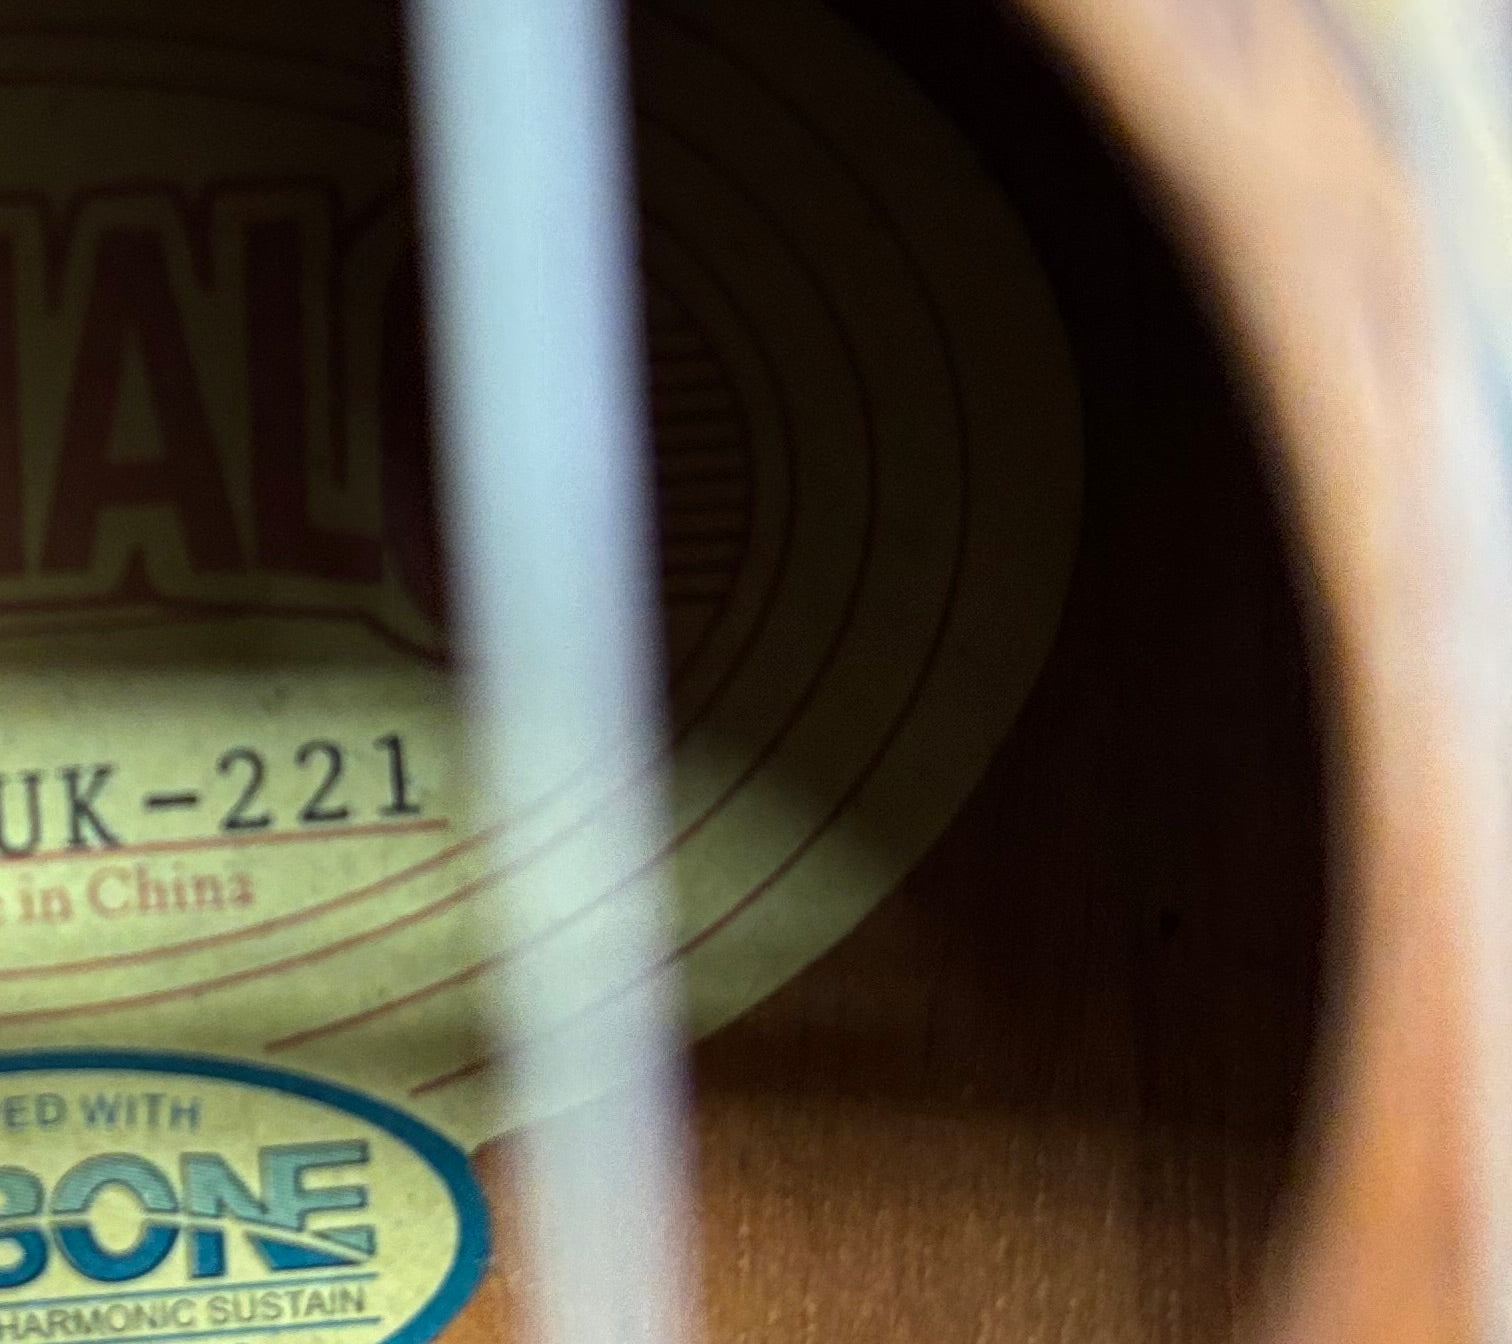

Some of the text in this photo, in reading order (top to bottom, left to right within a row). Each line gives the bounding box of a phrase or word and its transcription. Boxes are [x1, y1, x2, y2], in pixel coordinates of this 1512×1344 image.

[16, 877, 72, 922] in
[89, 861, 254, 916] China
[82, 1092, 202, 1133] WITH
[205, 1283, 366, 1327] SUSTAIN
